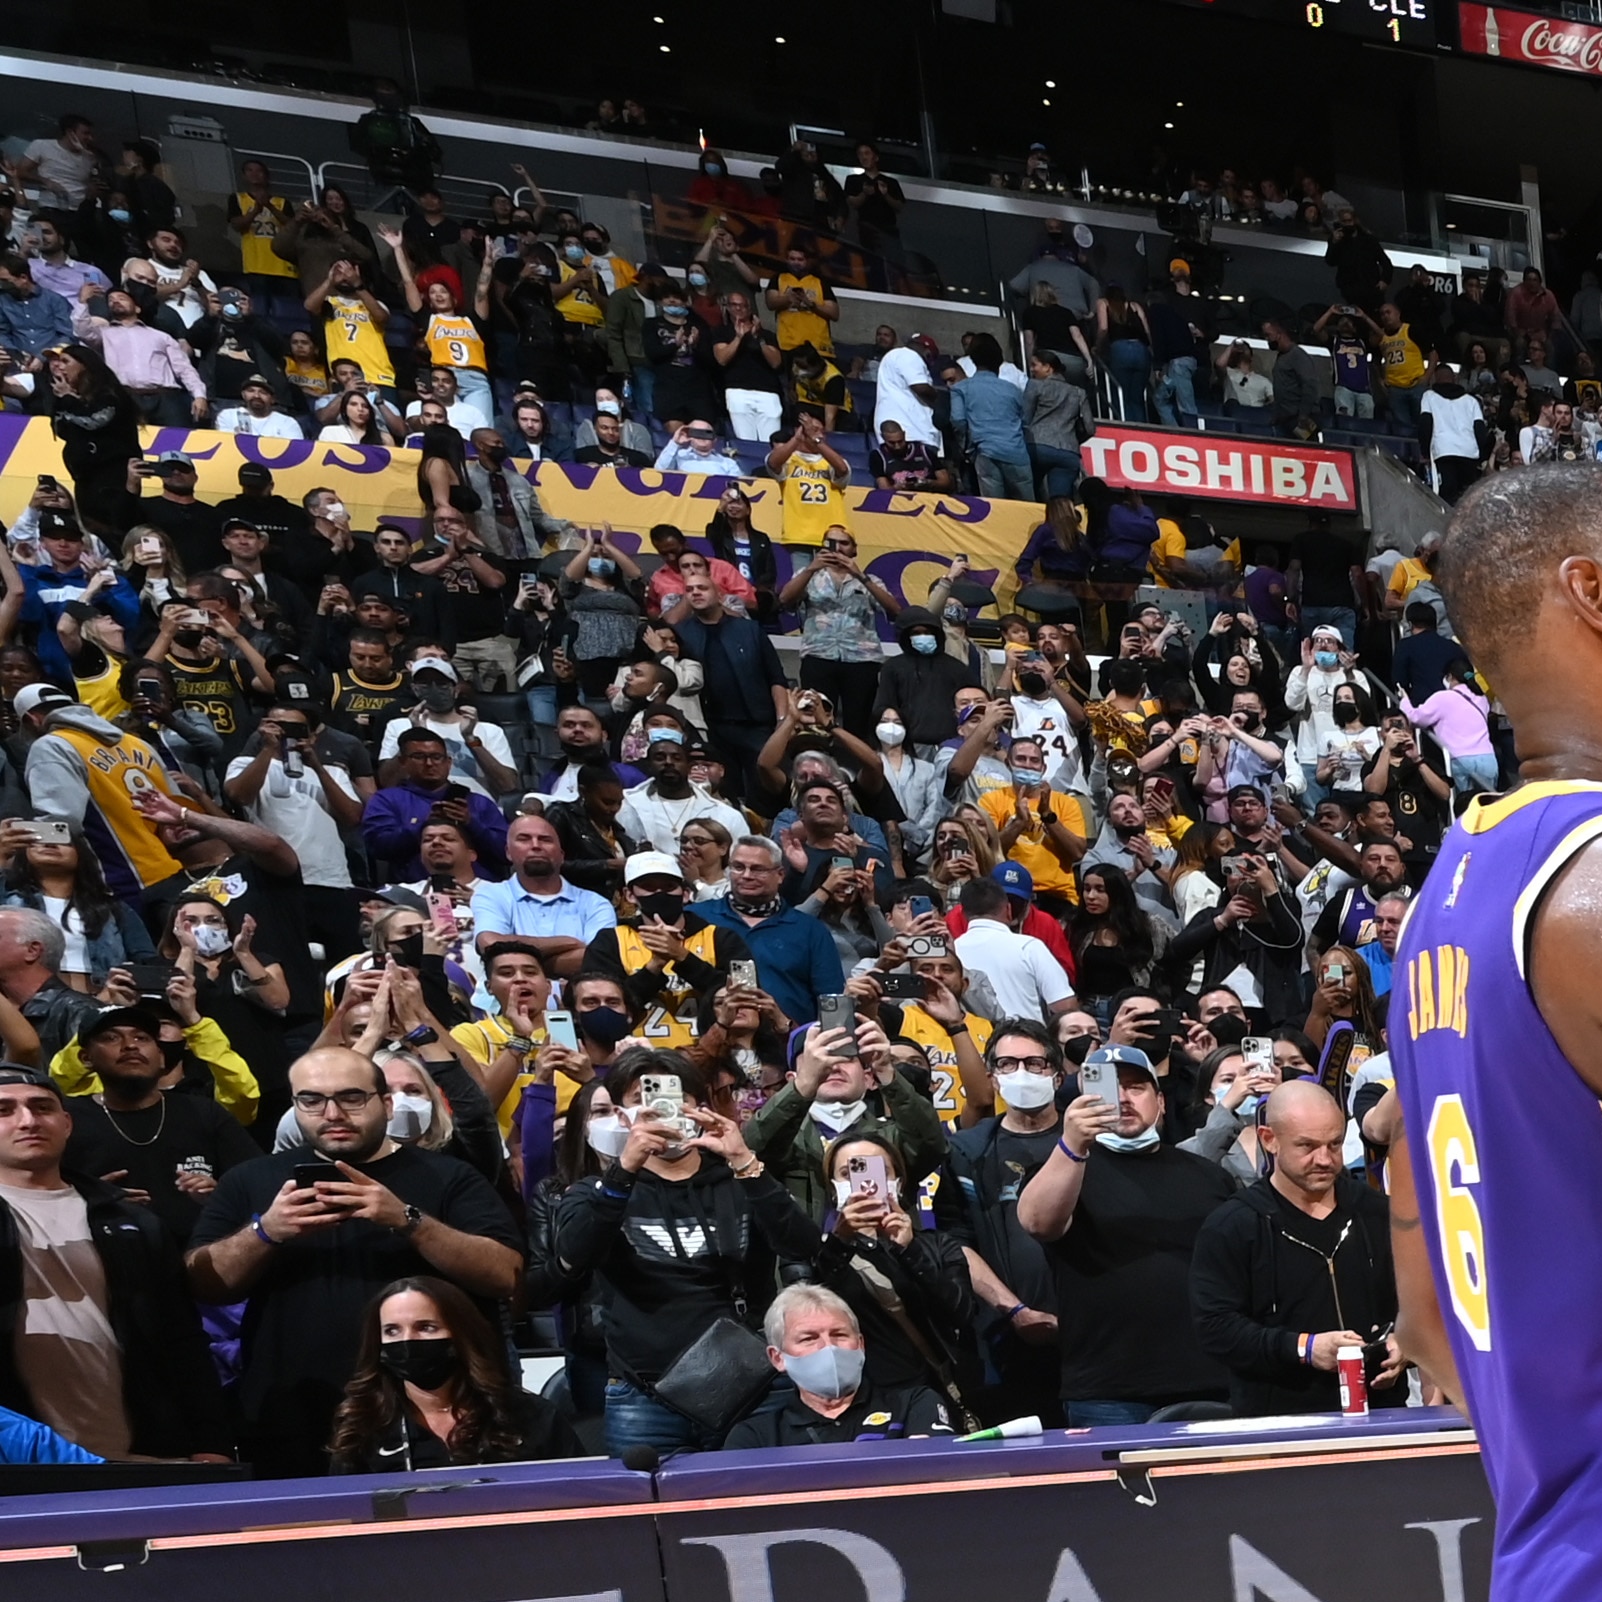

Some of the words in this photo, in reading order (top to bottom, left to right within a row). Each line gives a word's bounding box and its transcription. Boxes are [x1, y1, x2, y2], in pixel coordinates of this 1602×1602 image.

[1387, 18, 1401, 42] 1
[345, 322, 358, 342] 7
[449, 341, 464, 362] 9
[1346, 354, 1359, 369] 3
[1388, 350, 1406, 364] 23
[782, 465, 825, 482] LAKERS
[1081, 437, 1349, 502] TOSHIBA
[798, 481, 827, 505] 23
[442, 568, 485, 595] 24
[741, 562, 754, 579] 6
[1399, 790, 1418, 815] 8
[642, 1000, 700, 1038] 24
[1427, 1093, 1492, 1353] 6
